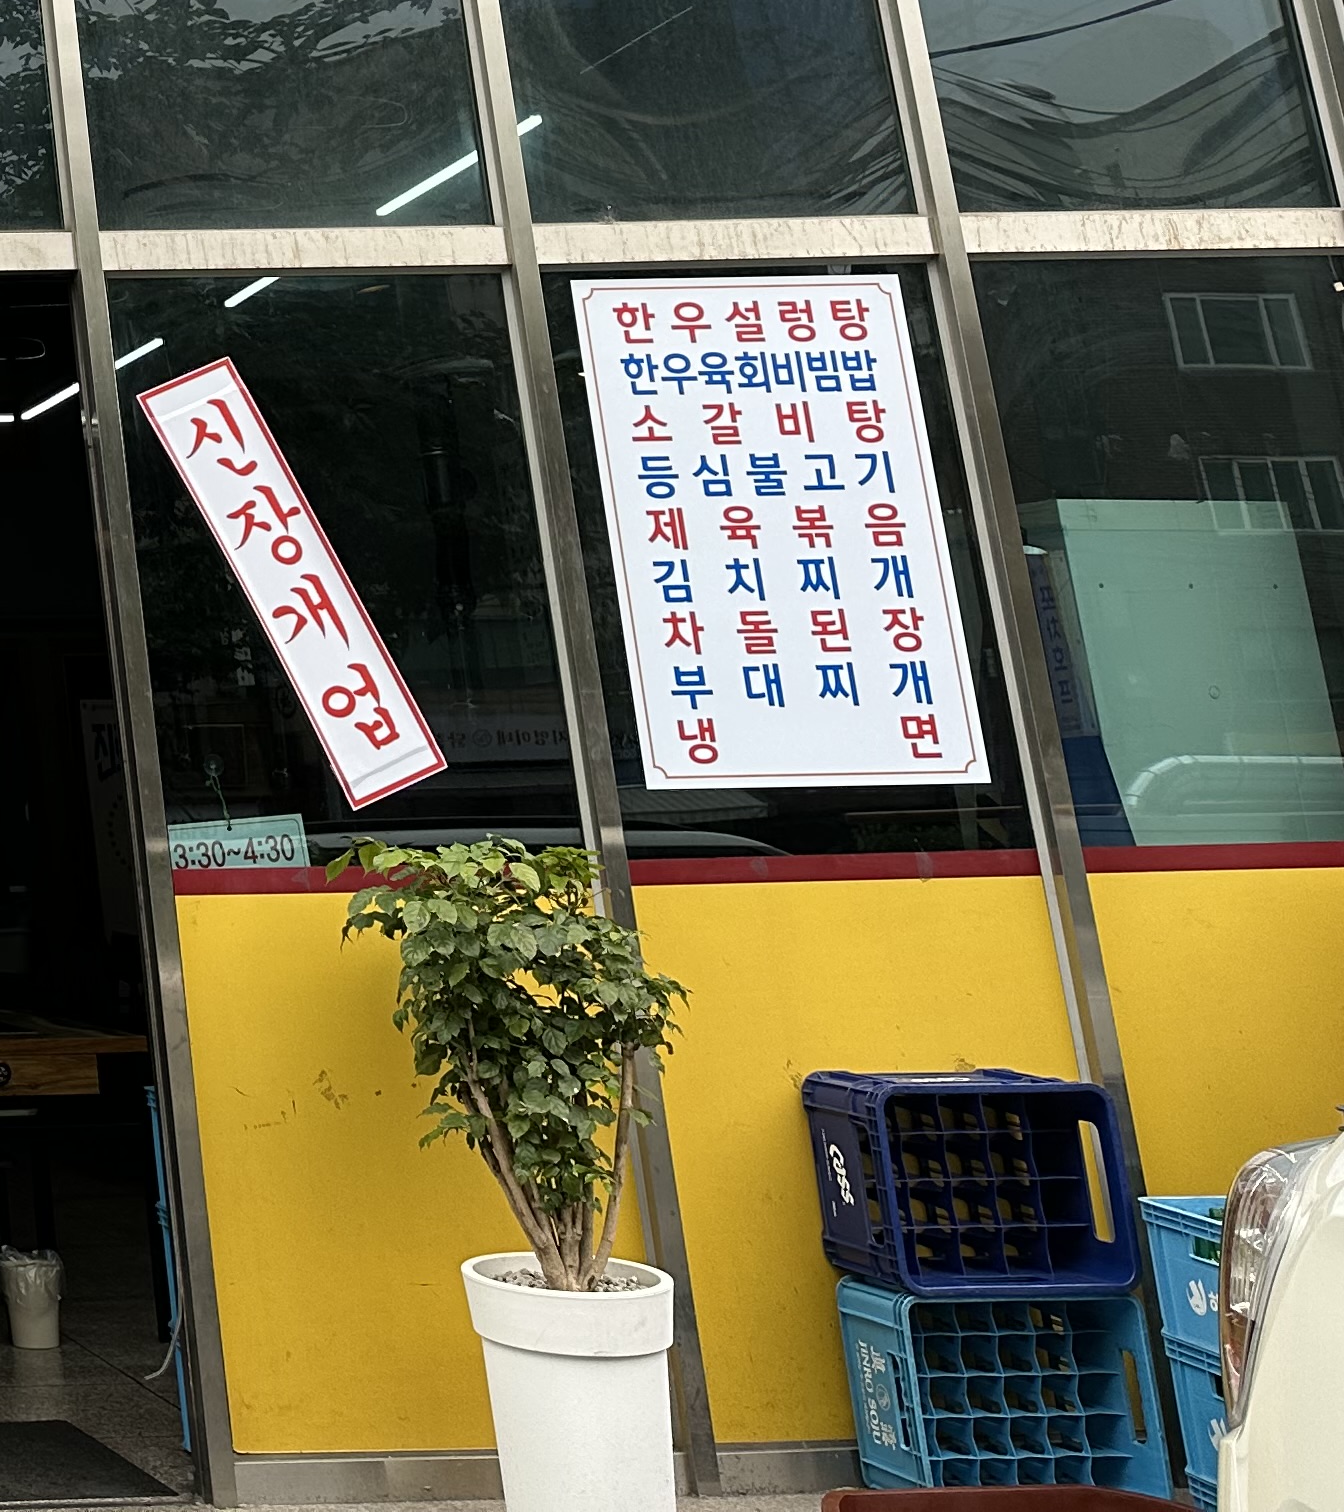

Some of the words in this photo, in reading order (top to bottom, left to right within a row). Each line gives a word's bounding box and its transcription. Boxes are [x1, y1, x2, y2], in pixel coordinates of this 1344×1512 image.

[615, 301, 867, 343] 한우설렁탕
[621, 352, 876, 395] 한우육회비빔밥
[632, 402, 884, 444] 소갈비탕
[640, 452, 894, 499] 등심불고기
[649, 504, 902, 548] 제육볶음
[186, 398, 401, 752] 신장개업
[655, 555, 913, 602] 김치찌개
[666, 609, 922, 653] 차돌된장
[672, 661, 932, 709] 부대찌개
[857, 1339, 874, 1393] JINRO
[868, 1397, 882, 1445] SOJU
